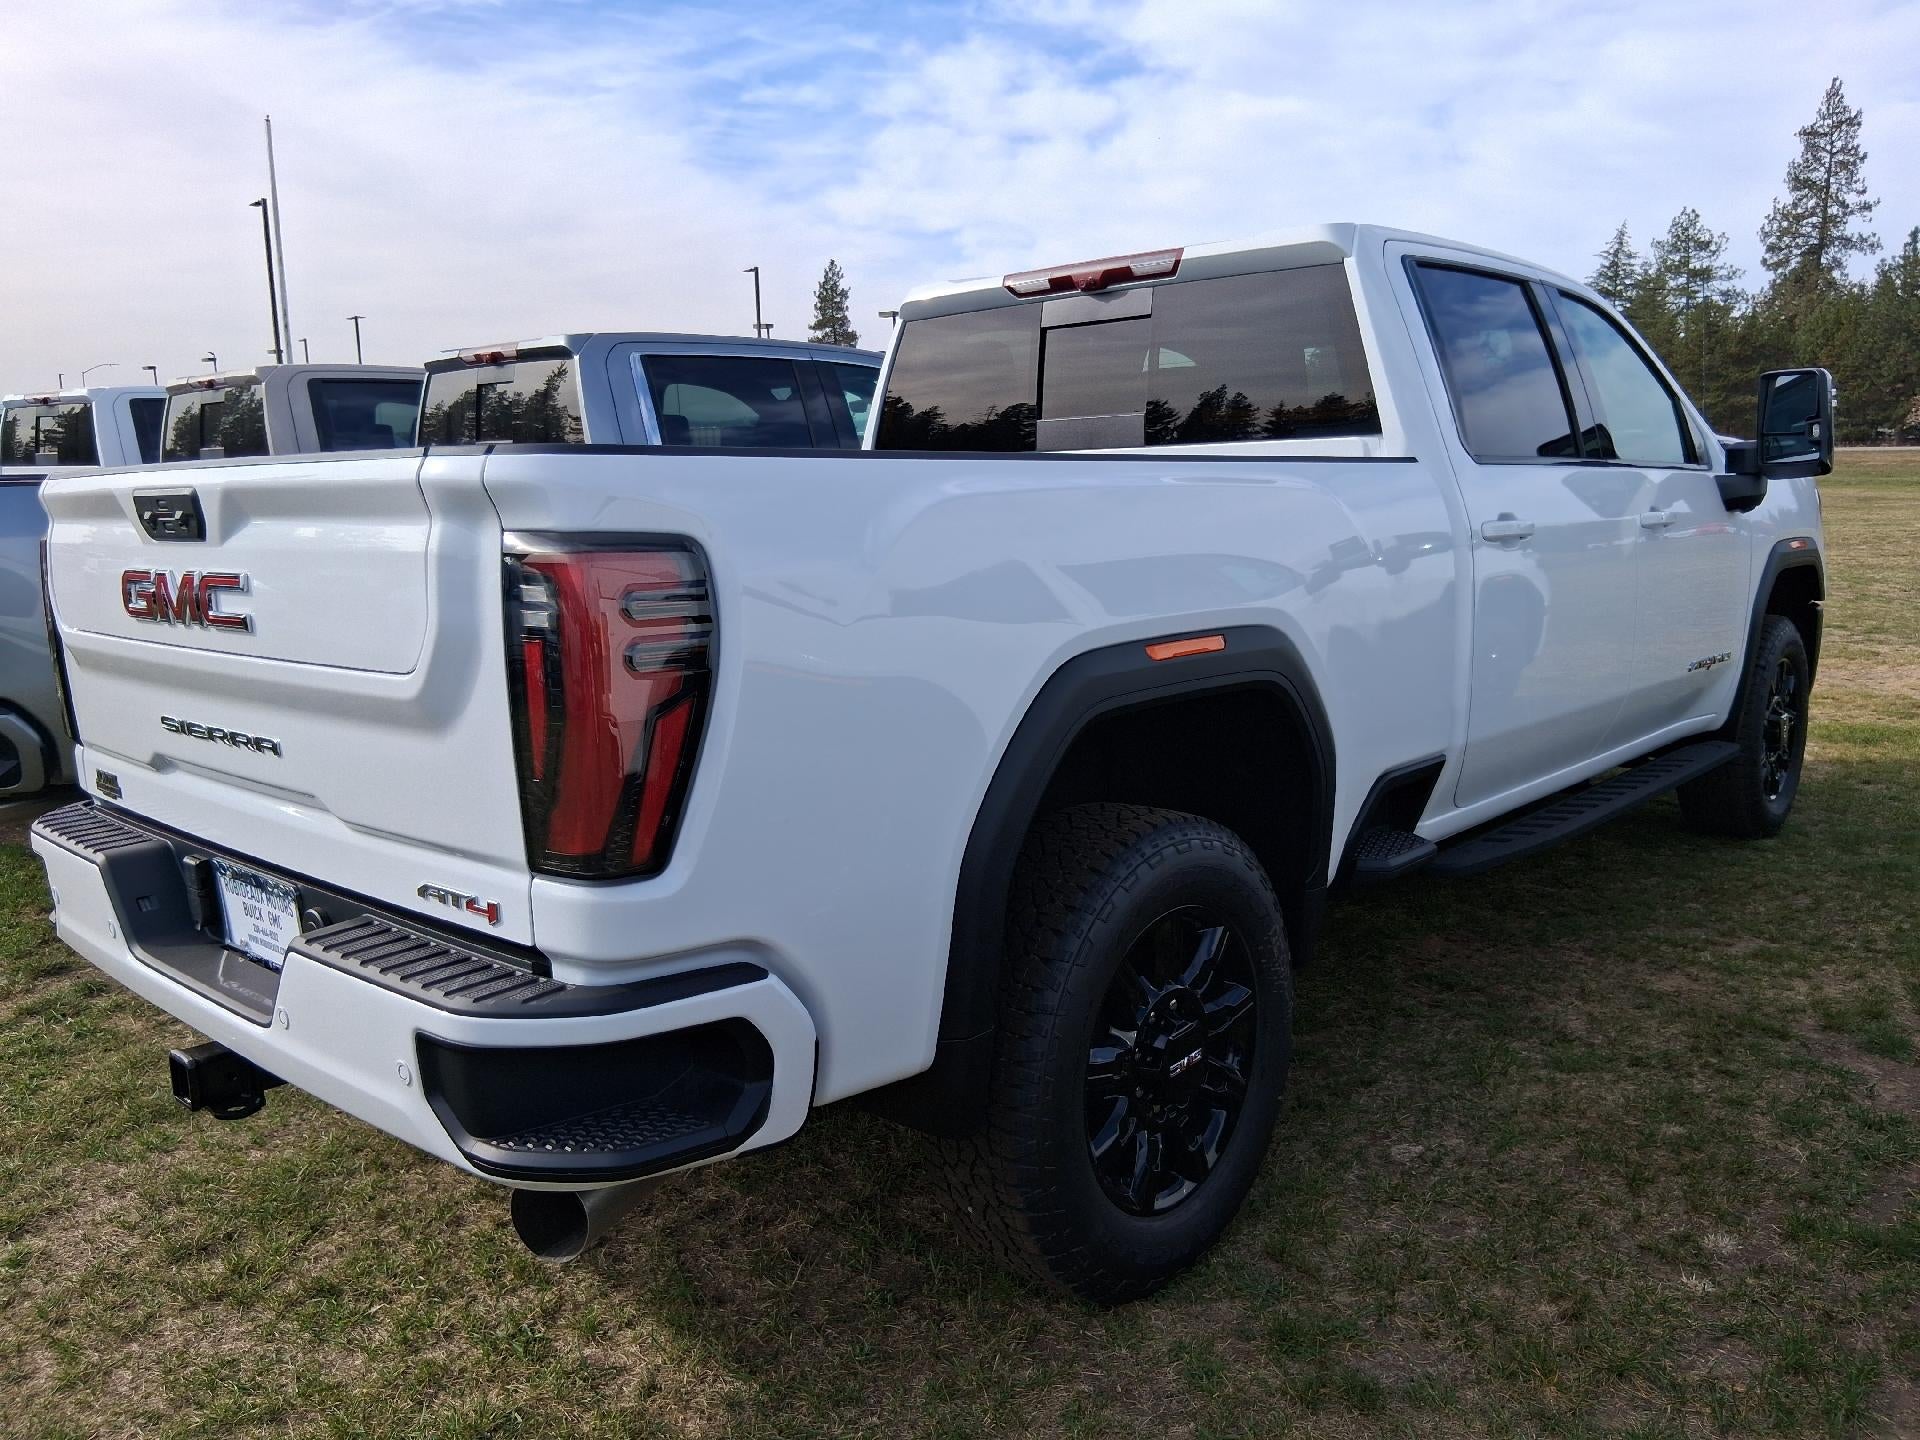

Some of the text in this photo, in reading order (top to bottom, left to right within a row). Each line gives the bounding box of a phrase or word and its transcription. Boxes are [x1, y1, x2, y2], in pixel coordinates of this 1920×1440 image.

[121, 568, 252, 632] GMC
[160, 715, 282, 757] SIERRA
[242, 901, 283, 930] BUICK GMC
[417, 883, 501, 926] AT4
